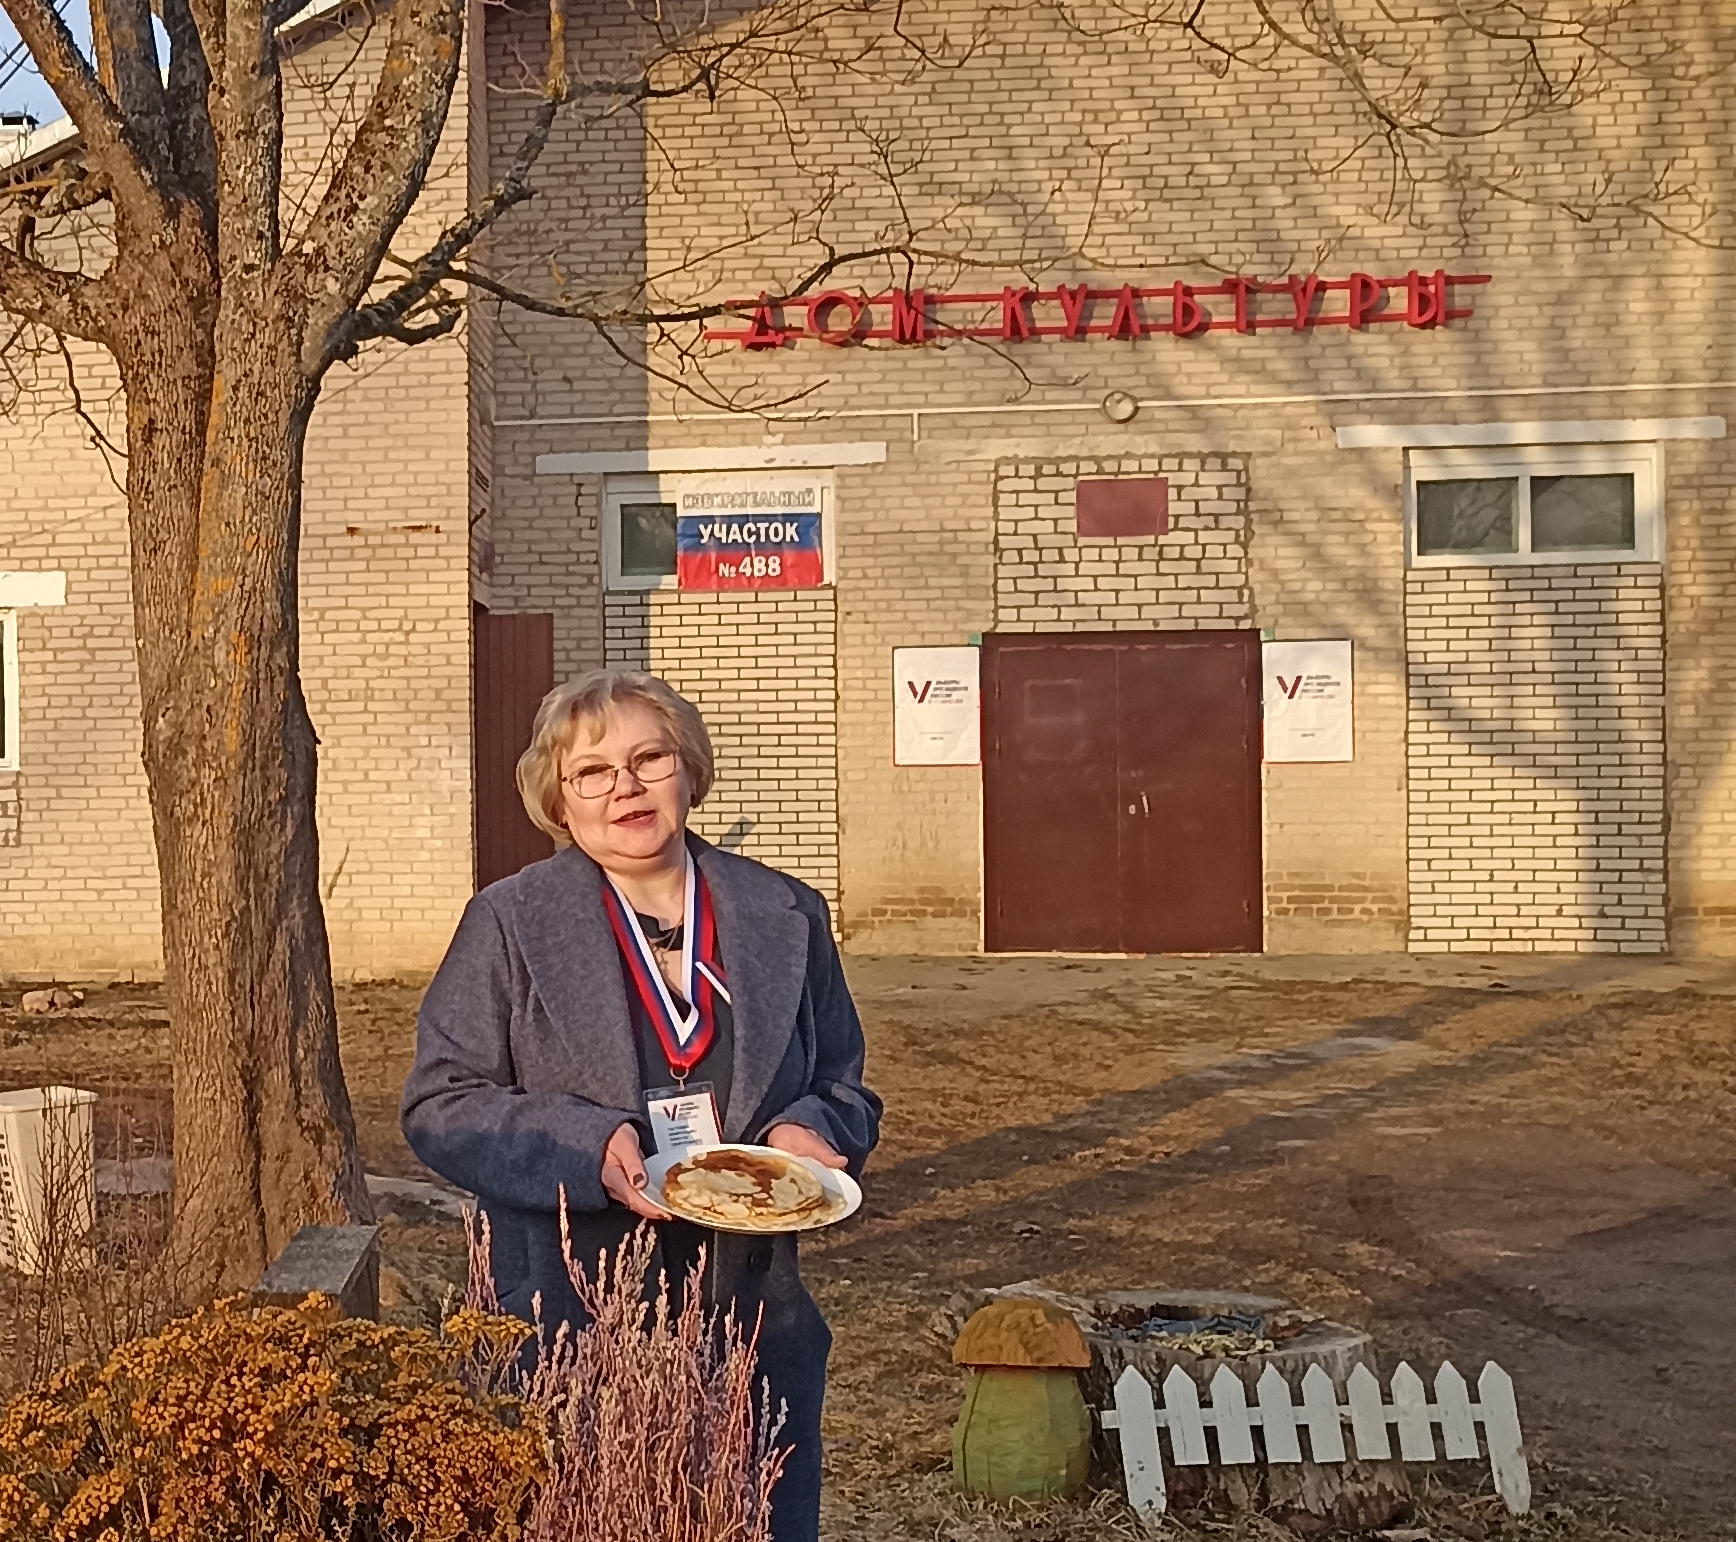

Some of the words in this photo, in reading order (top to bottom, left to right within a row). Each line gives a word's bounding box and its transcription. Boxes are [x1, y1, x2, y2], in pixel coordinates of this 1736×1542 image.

[741, 288, 925, 350] ДОМ
[1002, 269, 1446, 342] КУЛЬТУРЫ
[682, 487, 816, 510] ИЗБИРАТЕЛЬНЫЙ
[698, 521, 800, 544] УЧАСТОК
